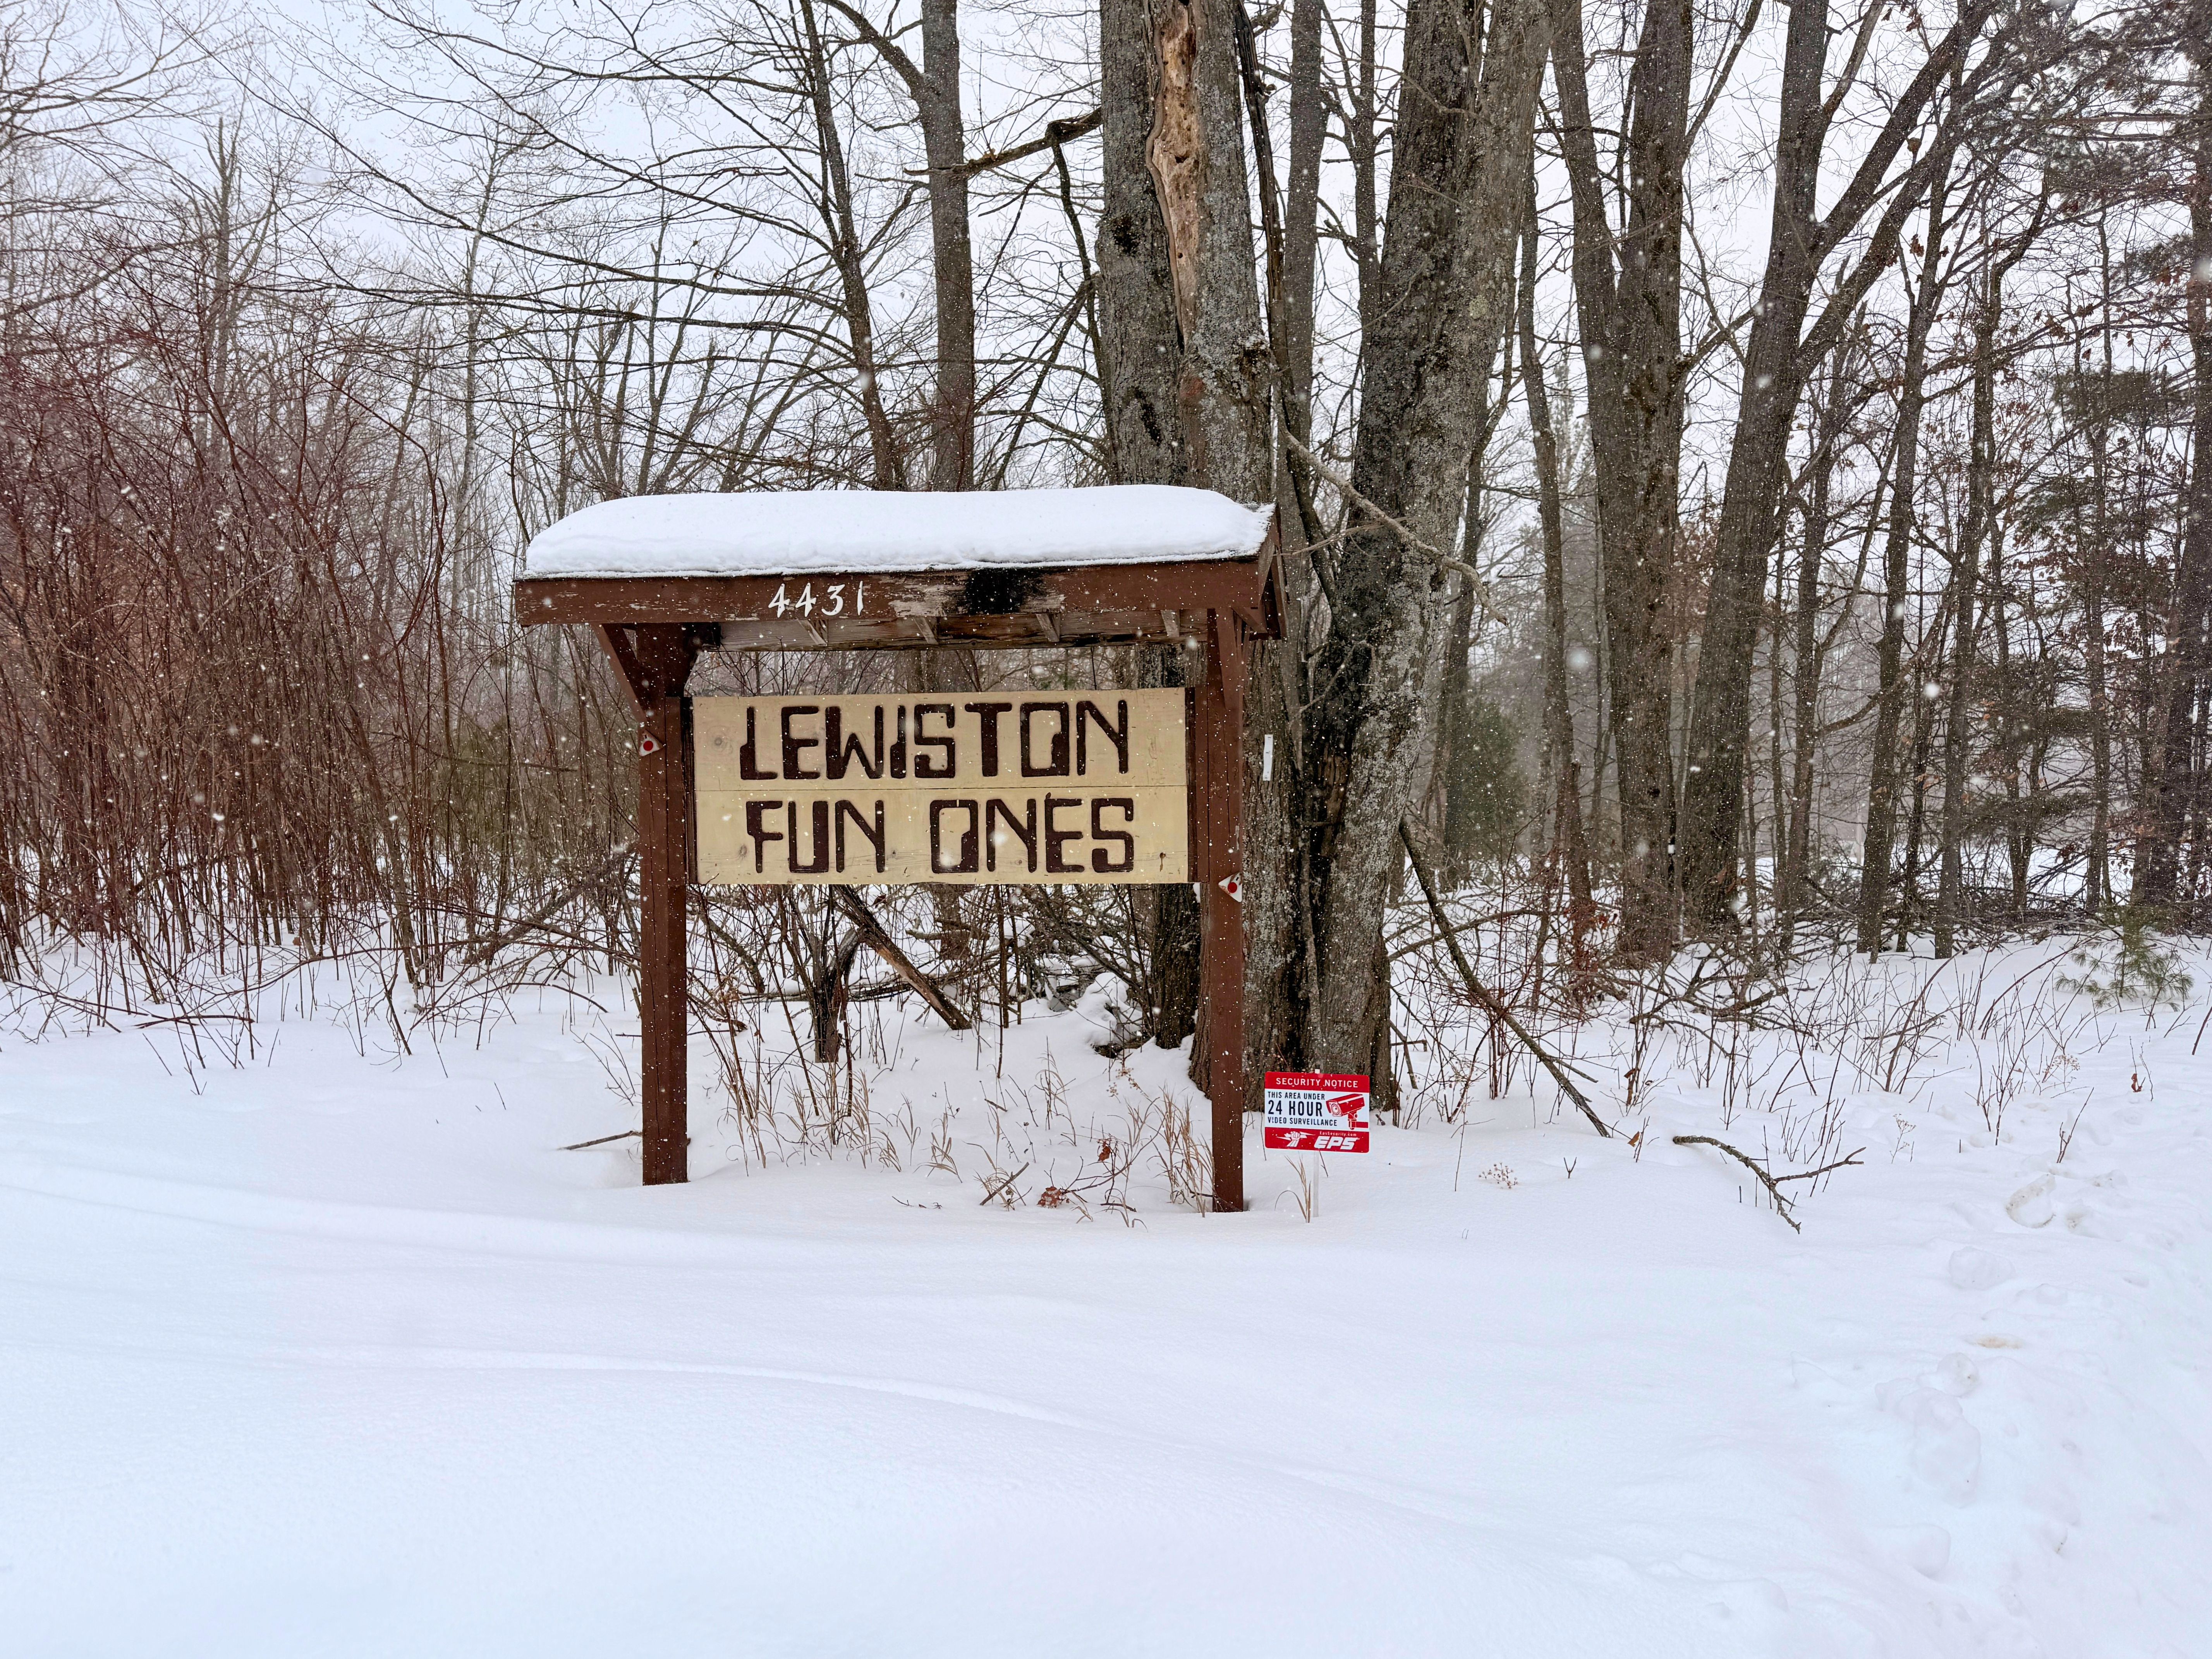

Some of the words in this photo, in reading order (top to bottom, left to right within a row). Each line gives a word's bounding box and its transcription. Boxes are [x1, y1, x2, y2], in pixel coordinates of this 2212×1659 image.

[768, 581, 863, 618] 4431
[740, 700, 1129, 780] LEWISTON
[746, 800, 885, 873] FUN
[930, 797, 1134, 872] ONES
[1276, 1078, 1321, 1086] SECURITY
[1324, 1080, 1358, 1088] NOTICE
[1268, 1100, 1282, 1115] 24
[1289, 1101, 1322, 1116] HOUR
[1290, 1118, 1337, 1126] SURVEILLANCE
[1314, 1136, 1360, 1150] EPS
